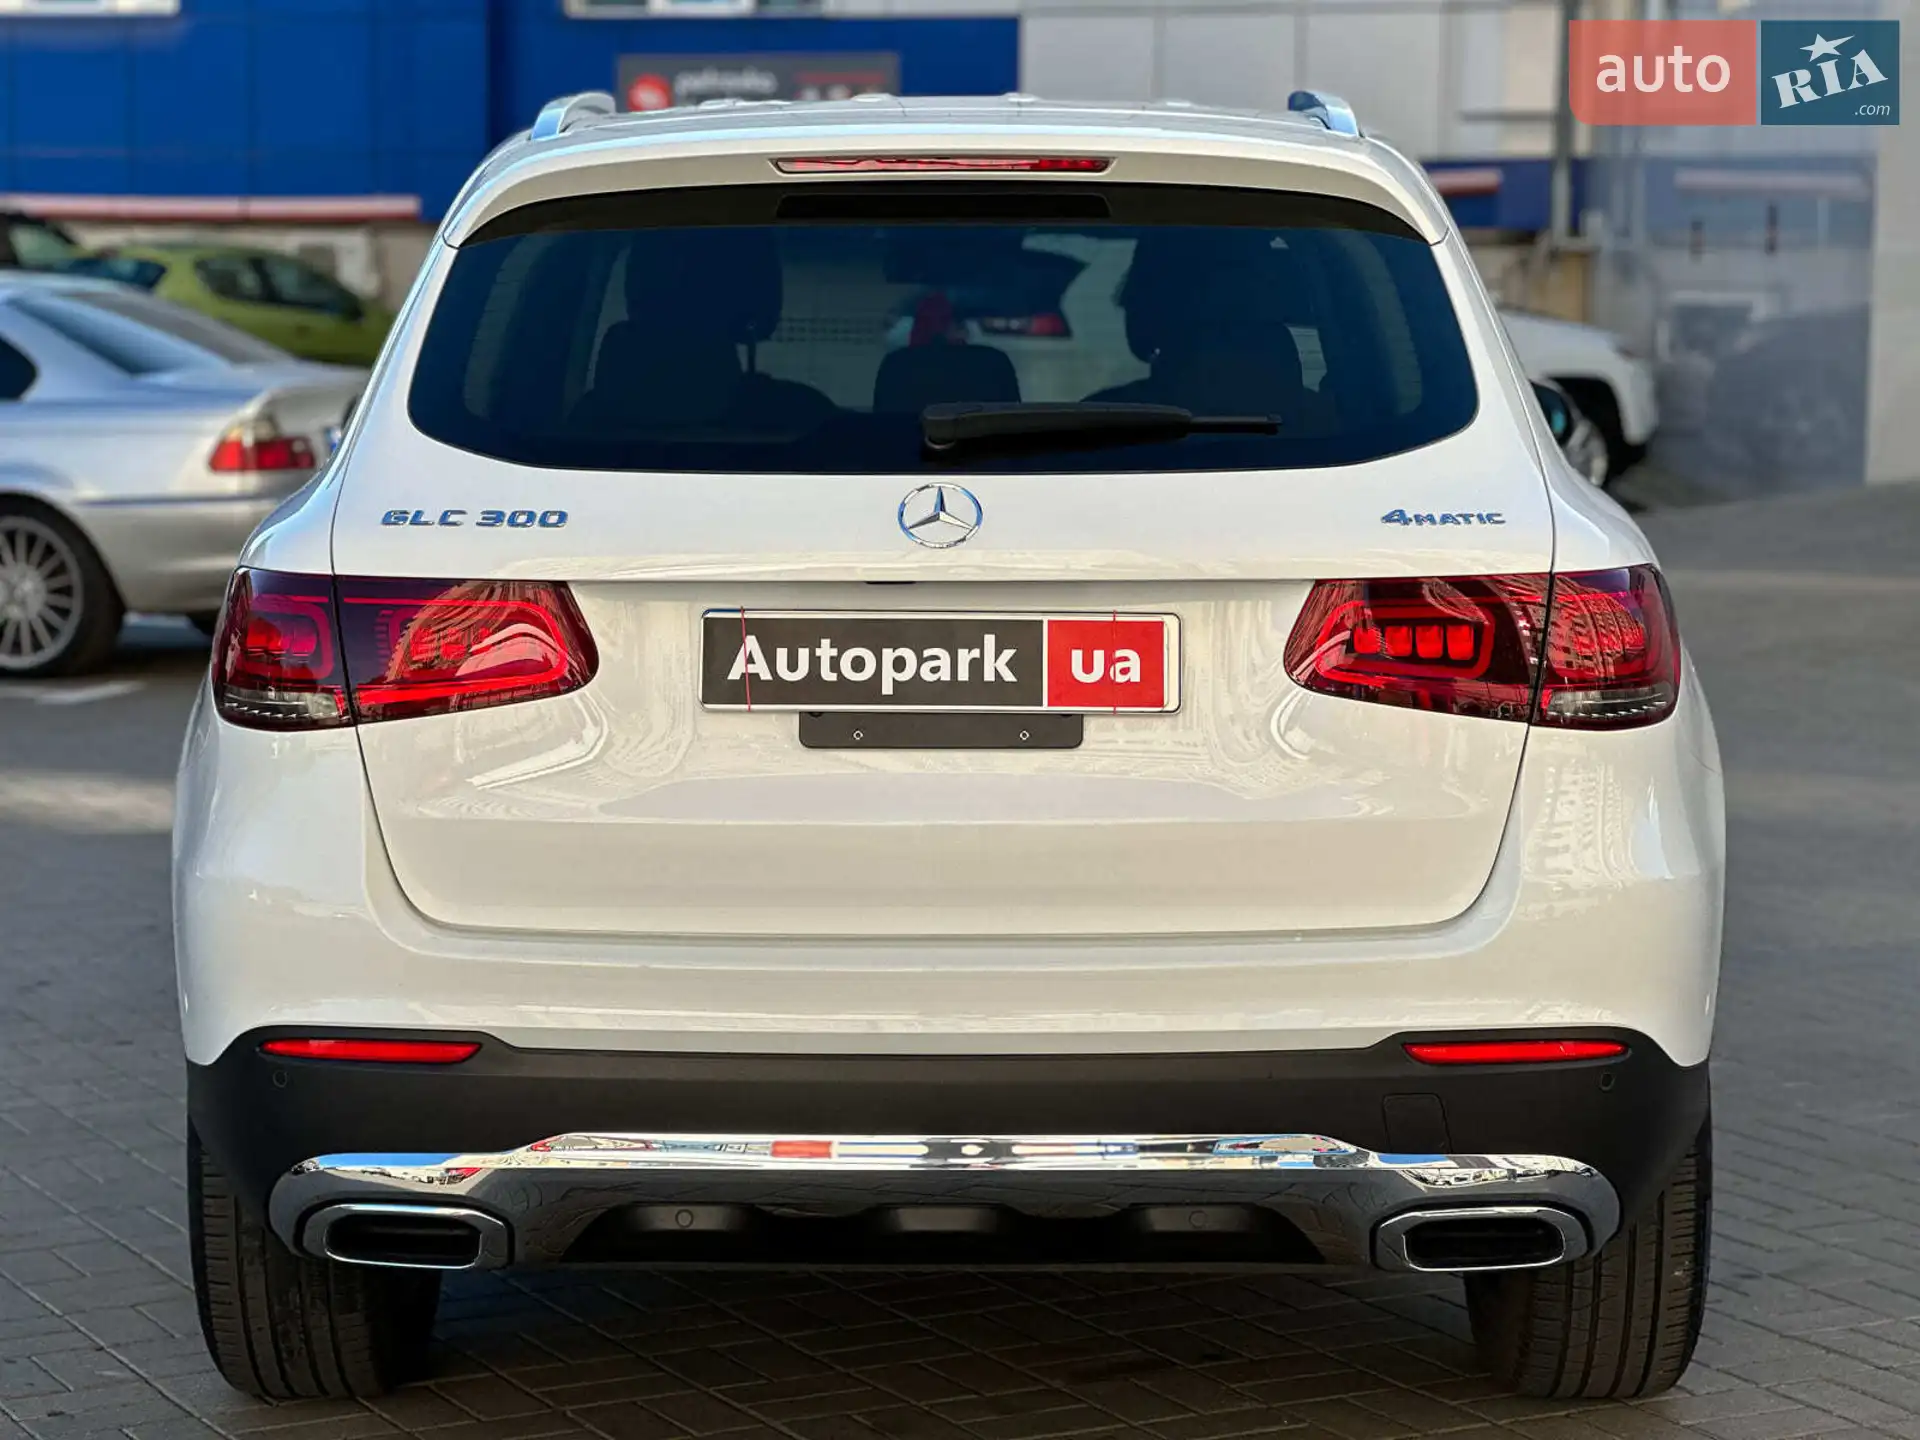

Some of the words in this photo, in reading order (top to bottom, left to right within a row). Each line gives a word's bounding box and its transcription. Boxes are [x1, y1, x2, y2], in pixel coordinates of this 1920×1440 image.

[381, 509, 468, 527] GLC
[475, 509, 569, 528] 300
[1380, 508, 1506, 526] 4MATIC
[727, 633, 1018, 696] Autopark
[1070, 648, 1142, 684] ua
